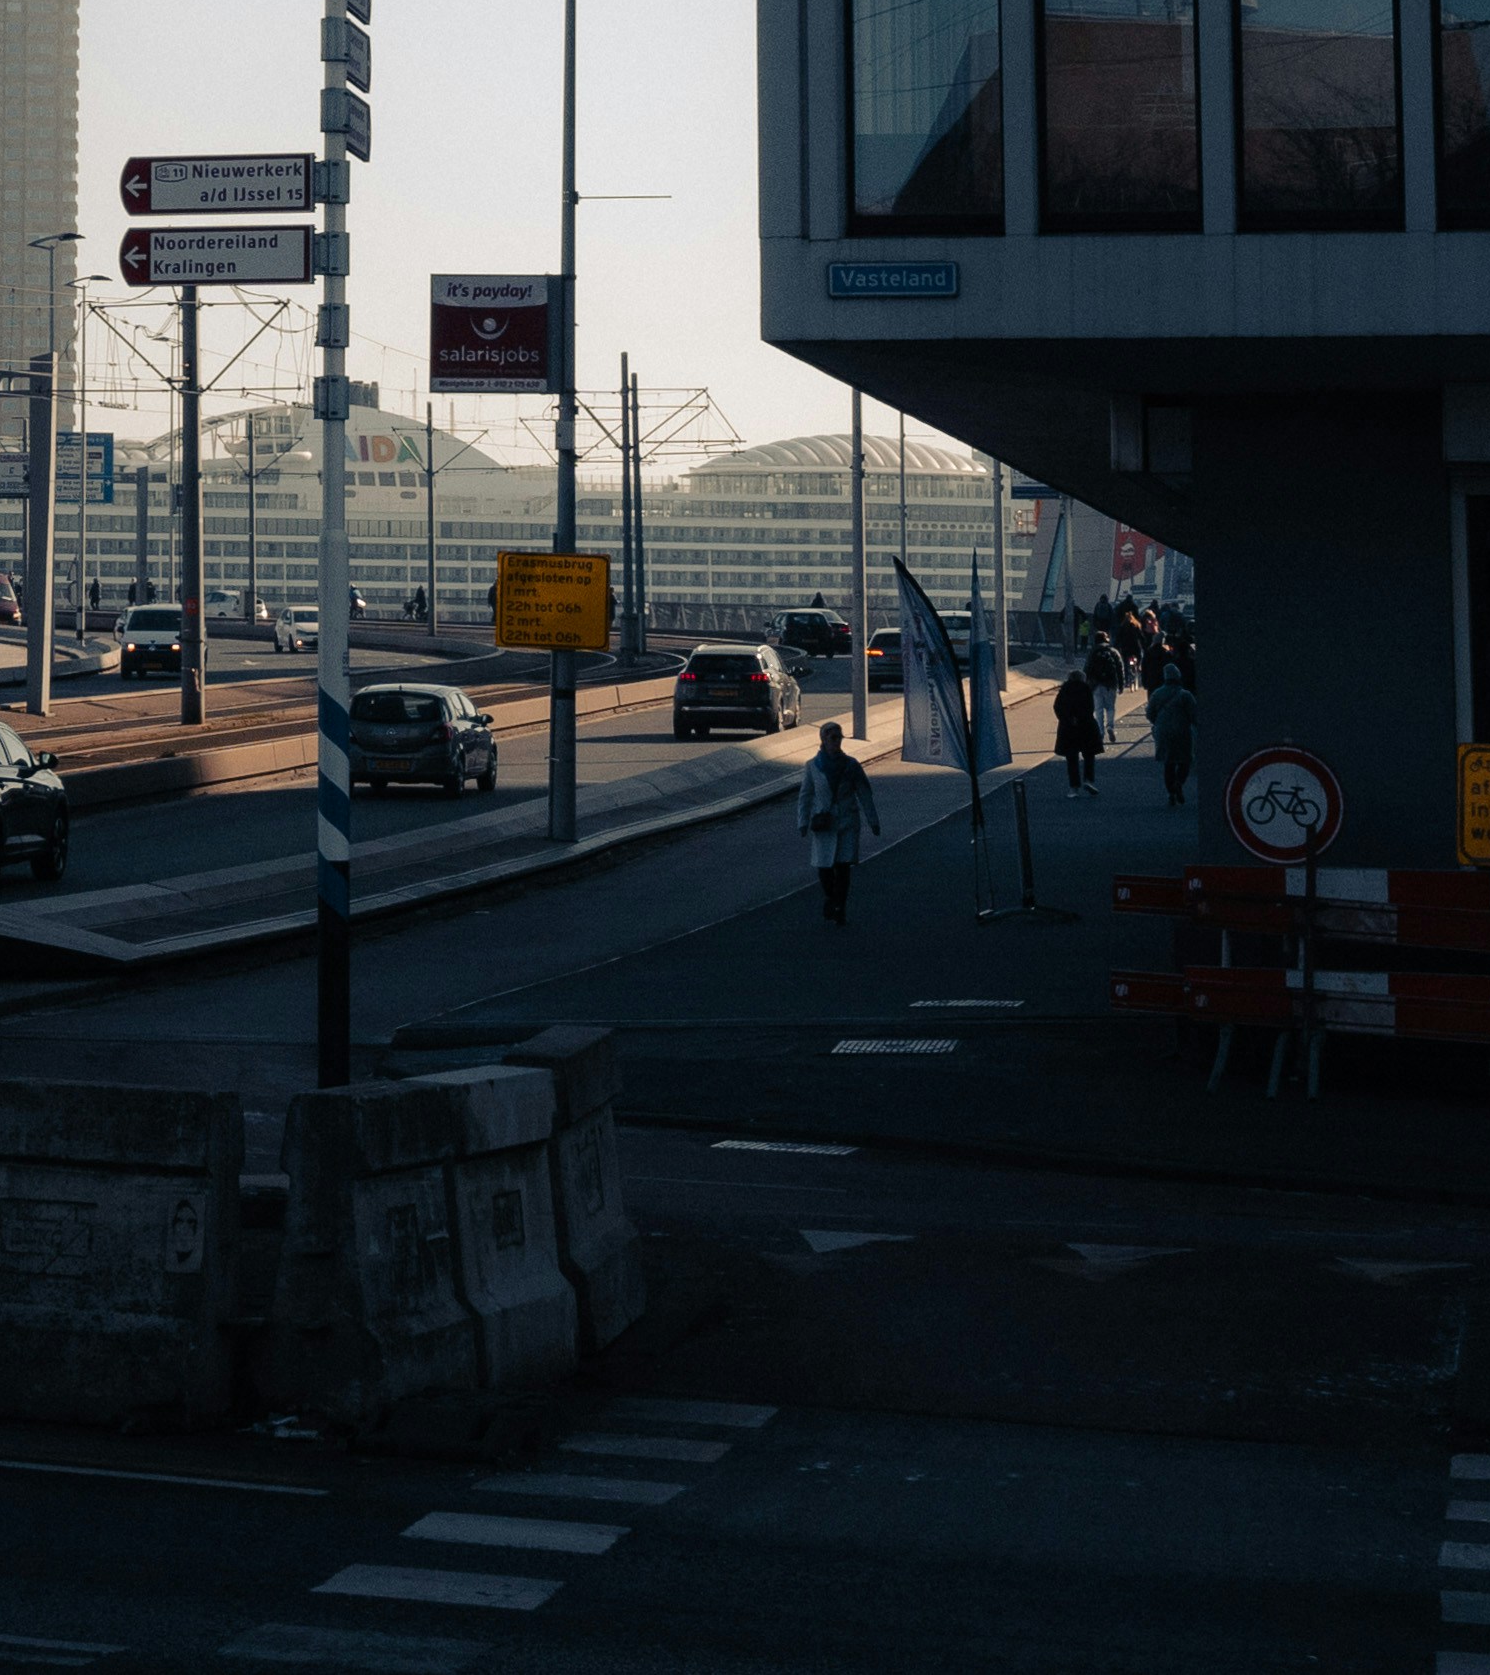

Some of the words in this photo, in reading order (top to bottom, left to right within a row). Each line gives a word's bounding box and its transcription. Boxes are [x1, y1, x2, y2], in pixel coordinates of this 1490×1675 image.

[191, 162, 303, 179] Nieuwerkerk
[200, 188, 227, 203] a/d
[234, 186, 281, 202] IJssel
[287, 189, 303, 201] 15
[153, 234, 279, 250] Noordereiland
[153, 260, 237, 277] Kralingen
[840, 269, 947, 288] Vasteland
[446, 283, 470, 298] it's
[472, 284, 534, 301] payday!
[439, 345, 540, 366] salarisjobs
[507, 556, 593, 573] Erasmusbrug
[506, 572, 574, 586] afgesloten
[577, 577, 591, 586] op
[506, 601, 531, 612] 22h
[535, 603, 553, 613] tot
[556, 603, 582, 613] 06h
[506, 615, 514, 626] 2
[505, 630, 531, 641] 22h
[534, 632, 552, 642] tot
[555, 632, 582, 643] 06h
[1471, 802, 1489, 818] in
